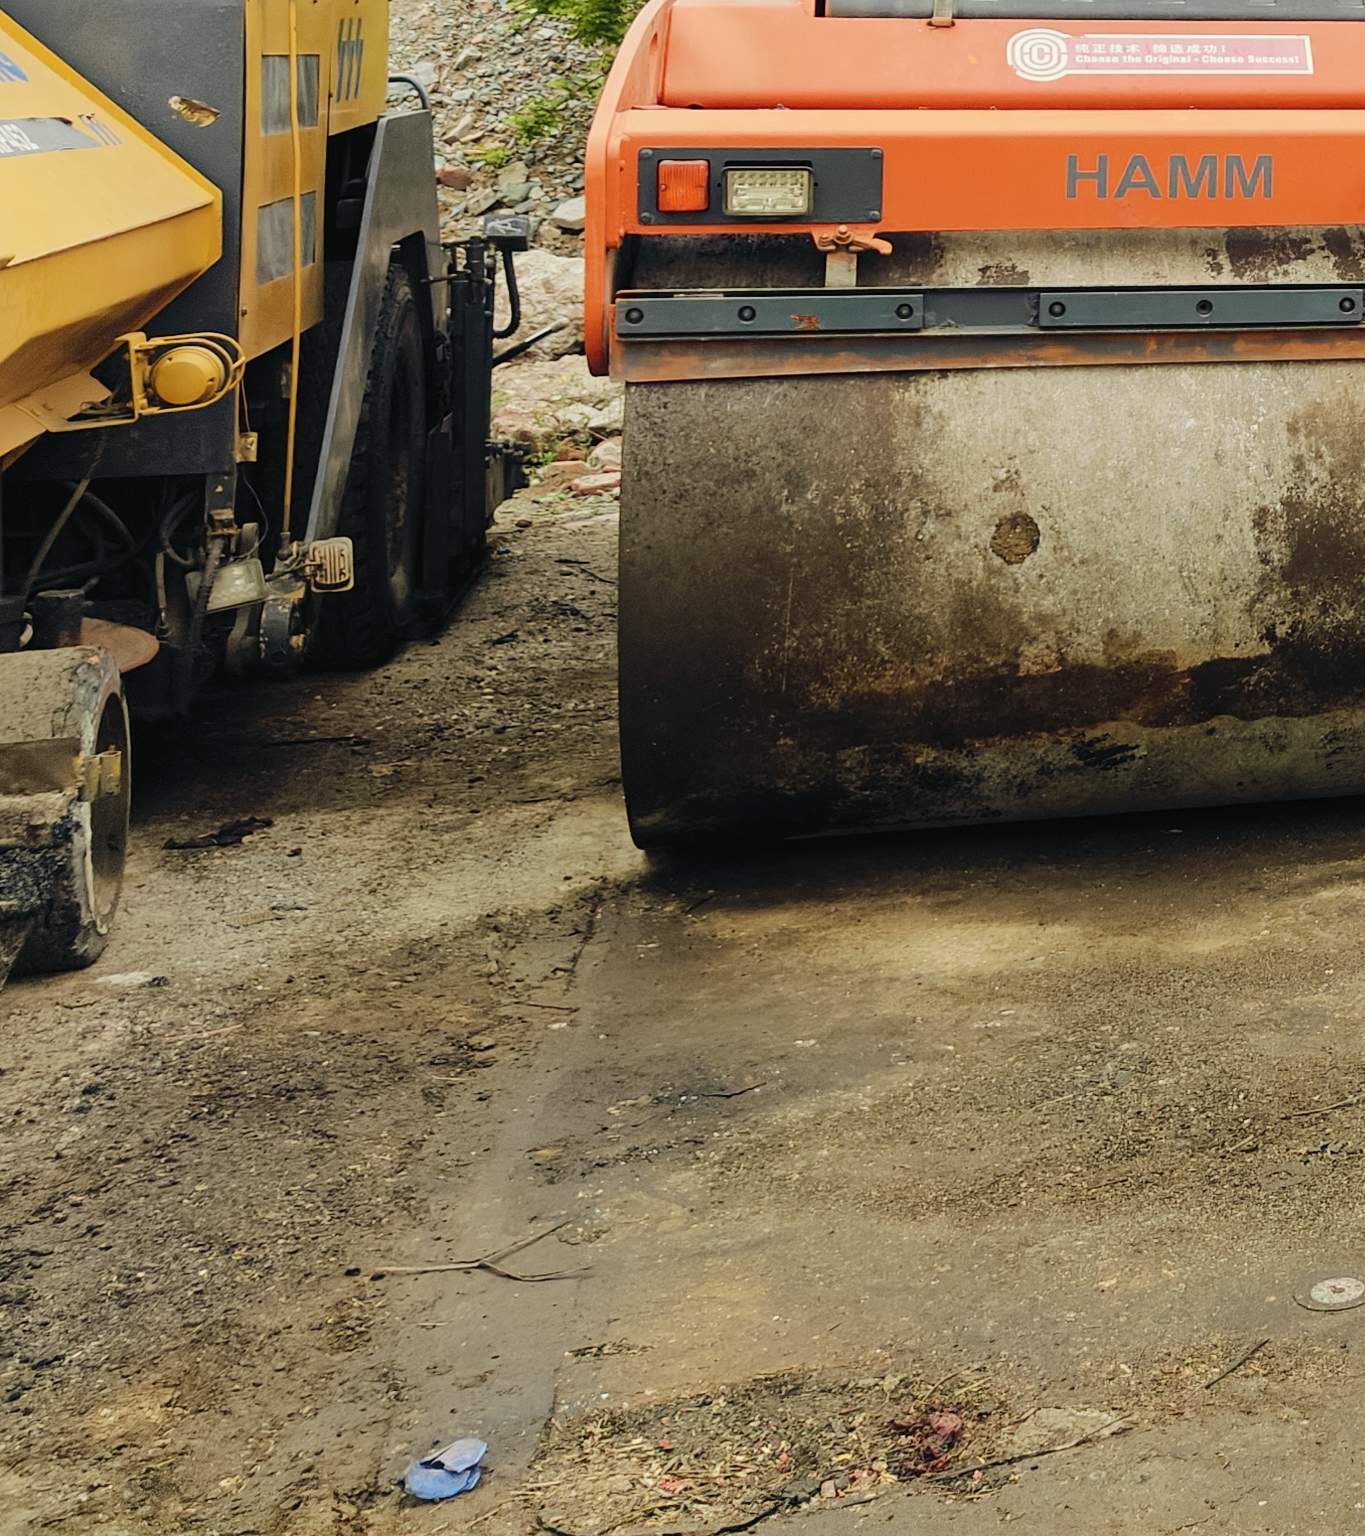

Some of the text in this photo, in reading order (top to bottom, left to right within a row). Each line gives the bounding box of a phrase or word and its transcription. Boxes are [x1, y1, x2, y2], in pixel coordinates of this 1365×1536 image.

[1122, 54, 1142, 64] the
[1145, 54, 1192, 66] Original
[1066, 154, 1273, 199] HAMM
